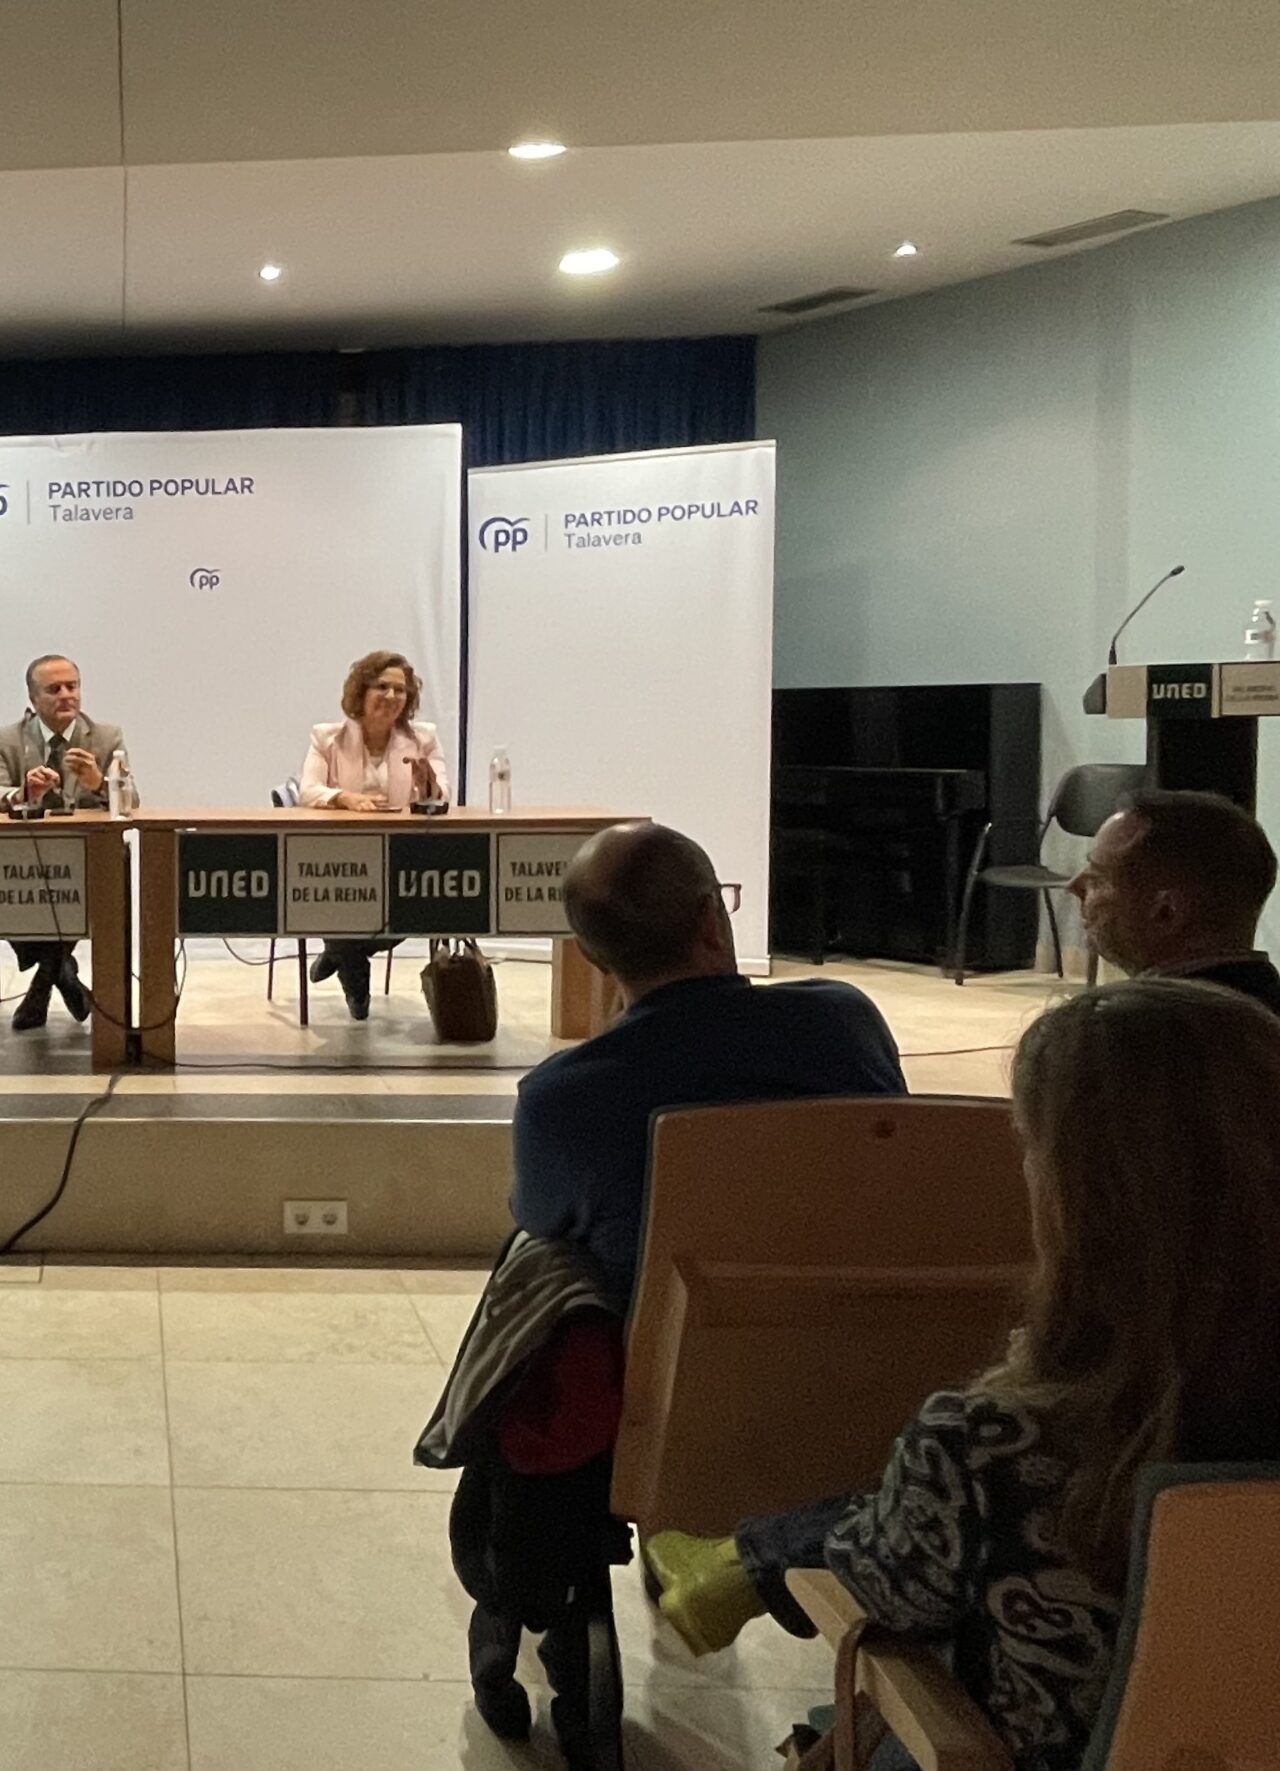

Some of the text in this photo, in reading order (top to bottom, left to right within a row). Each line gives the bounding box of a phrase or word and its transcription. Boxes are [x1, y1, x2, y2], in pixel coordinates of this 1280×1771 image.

[48, 477, 255, 499] PARTIDO POPULAR
[49, 503, 134, 522] Talavera
[564, 500, 758, 529] PARTIDO POPULAR
[565, 531, 642, 549] Talavera
[1152, 683, 1208, 699] UNED
[4, 864, 72, 880] TALAVERA
[298, 862, 368, 878] TALAVERA
[510, 861, 568, 877] TALAVE
[187, 869, 269, 898] UNED
[398, 869, 481, 898] UNED
[19, 889, 35, 905] LA
[39, 889, 81, 905] REINA
[292, 887, 377, 902] DE LA REINA
[505, 887, 522, 902] DE
[527, 887, 544, 902] LA
